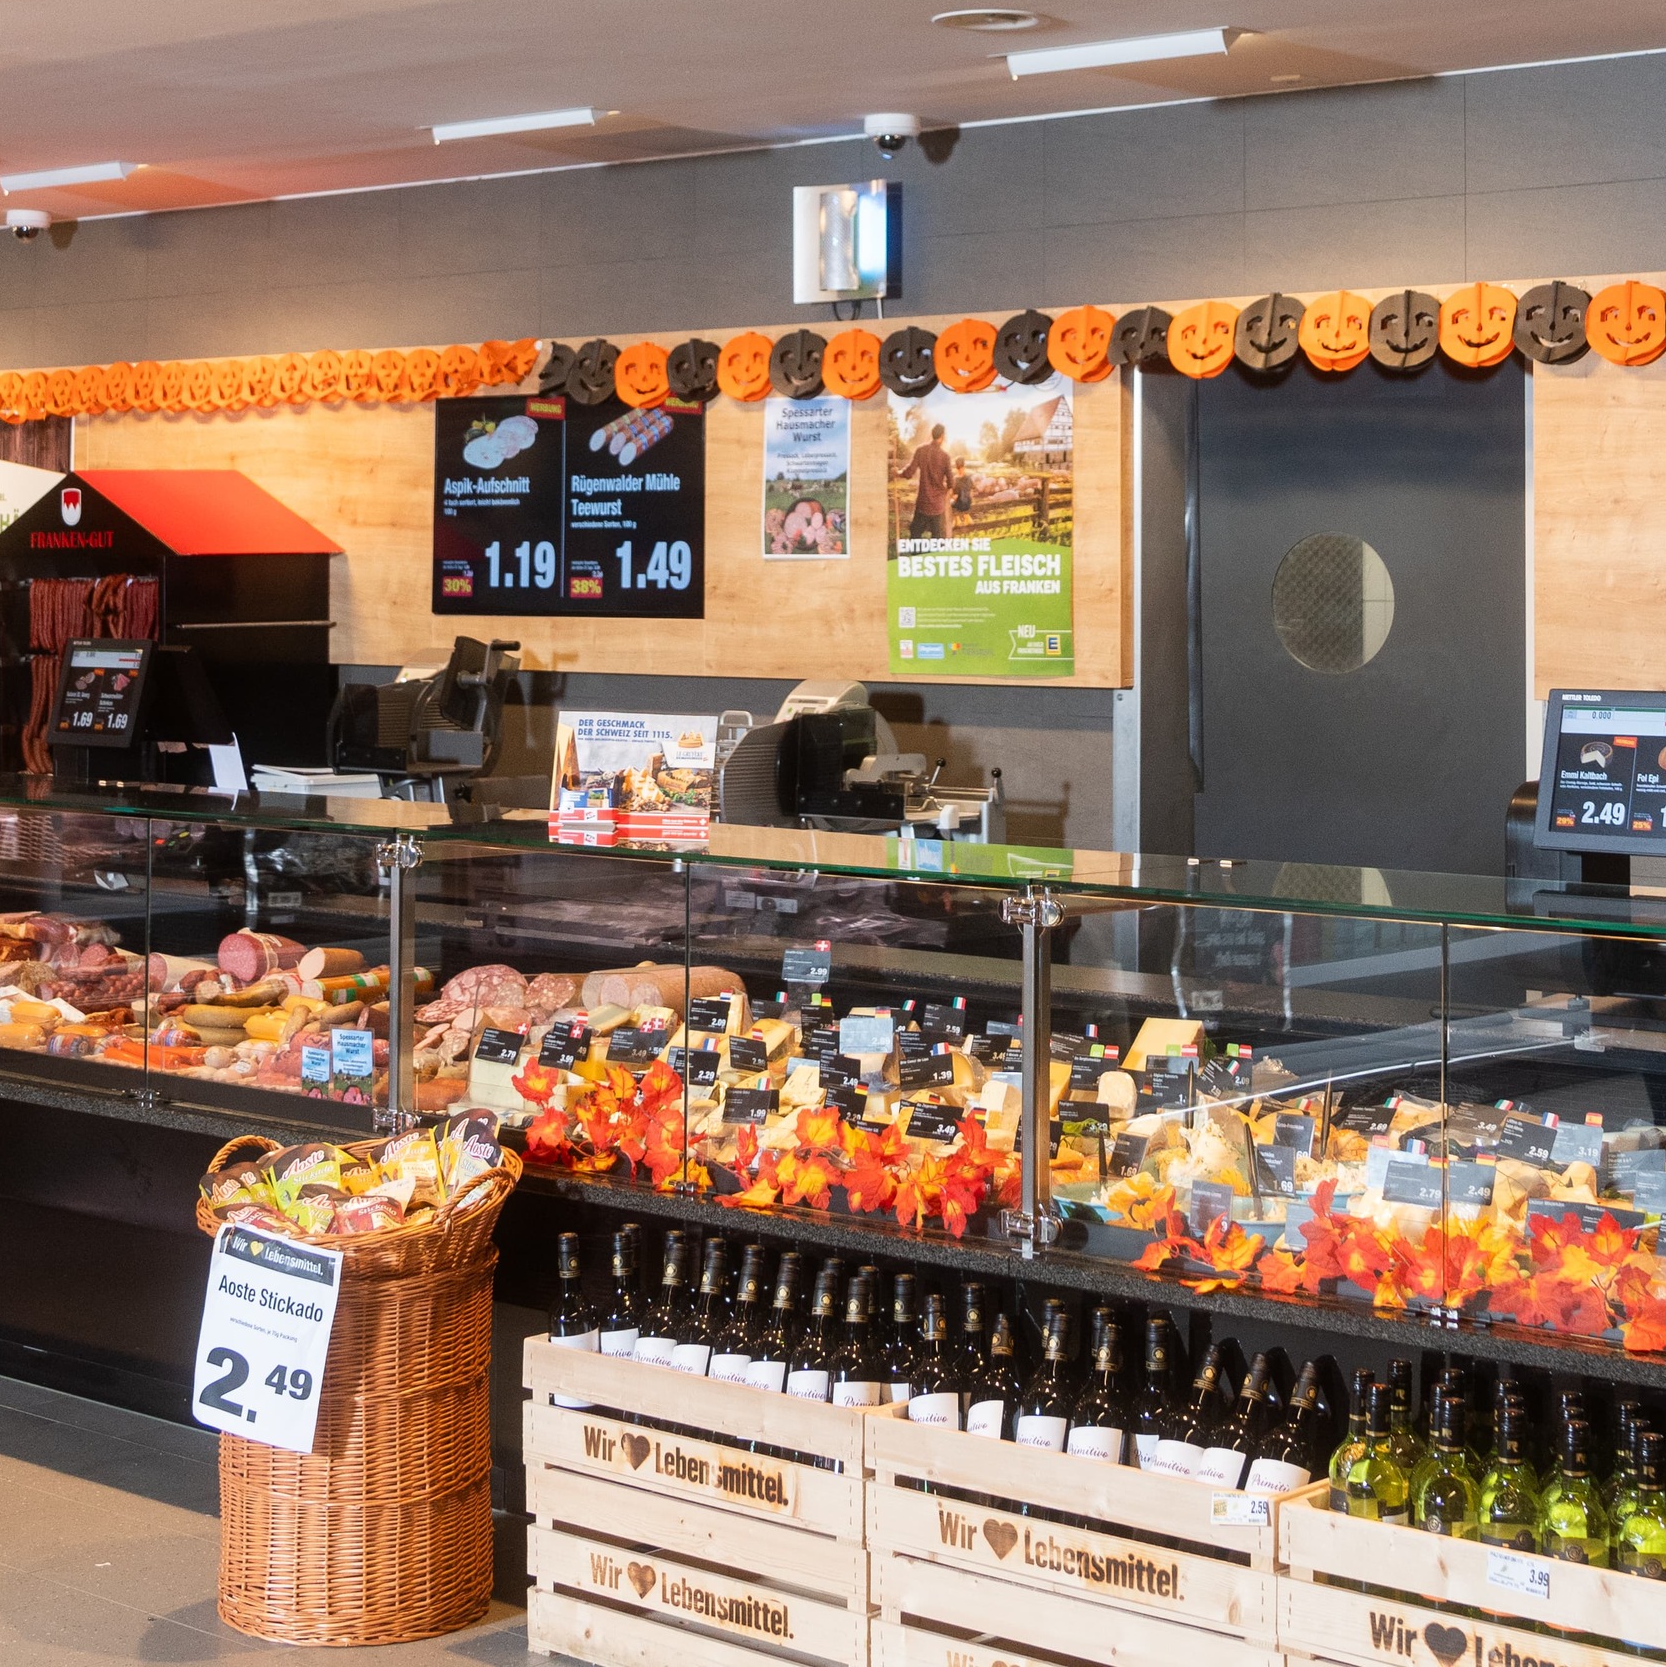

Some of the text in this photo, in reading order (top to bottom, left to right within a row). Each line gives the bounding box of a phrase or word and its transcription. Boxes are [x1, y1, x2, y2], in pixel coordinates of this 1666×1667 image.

[782, 407, 833, 419] Spessarter
[776, 419, 836, 430] Hausmacher
[793, 432, 821, 442] Wurst
[444, 477, 531, 497] Aspik-Aufschnitt
[571, 473, 681, 496] Rügenwalder Mühle
[571, 499, 622, 516] Teewurst
[30, 530, 114, 549] FRANKEN-GUT
[898, 537, 992, 553] ENTDECKEN SIE
[485, 540, 556, 588] 1.19
[615, 540, 692, 590] 1.49
[898, 554, 1061, 578] BESTES FLEISCH
[443, 578, 472, 592] 30%
[572, 579, 602, 593] 38%
[975, 580, 1061, 594] AUS FRANKEN
[1017, 625, 1036, 638] NEU
[73, 711, 93, 727] 1.69
[107, 713, 128, 729] 1.69
[1591, 711, 1612, 720] 0.000
[579, 719, 645, 729] DER GESCHMACK
[578, 728, 673, 739] DER SCHWEIZ SEIT 1115.
[1561, 770, 1608, 781] Emmi Kaltbach
[1581, 801, 1626, 826] 2.49
[810, 967, 828, 976] 2.99
[711, 1017, 726, 1027] 2.09
[946, 1024, 961, 1034] 2.59
[500, 1049, 516, 1059] 2.79
[559, 1054, 574, 1064] 3.99
[698, 1070, 715, 1080] 2.29
[843, 1076, 858, 1086] 2.49
[932, 1070, 952, 1081] 1.39
[750, 1108, 766, 1118] 1.99
[937, 1124, 956, 1135] 3.49
[1370, 1122, 1388, 1132] 2.69
[380, 1131, 420, 1164] Aoste
[463, 1134, 494, 1159] Aoste
[1528, 1145, 1549, 1159] 2.59
[1578, 1146, 1599, 1157] 3.19
[282, 1149, 325, 1180] Aoste
[1419, 1187, 1442, 1199] 2.79
[1468, 1186, 1491, 1198] 2.49
[233, 1236, 324, 1276] Wir Lebensmittel.
[218, 1274, 324, 1323] Aoste Stickado
[583, 1425, 789, 1506] Wir Lebensmittel.
[1250, 1500, 1268, 1514] 2.59
[938, 1508, 1186, 1601] Wir Lebensmittel.
[1528, 1569, 1550, 1587] 3.99
[590, 1552, 795, 1640] Wir Lebensmittel.
[1369, 1611, 1417, 1657] Wir
